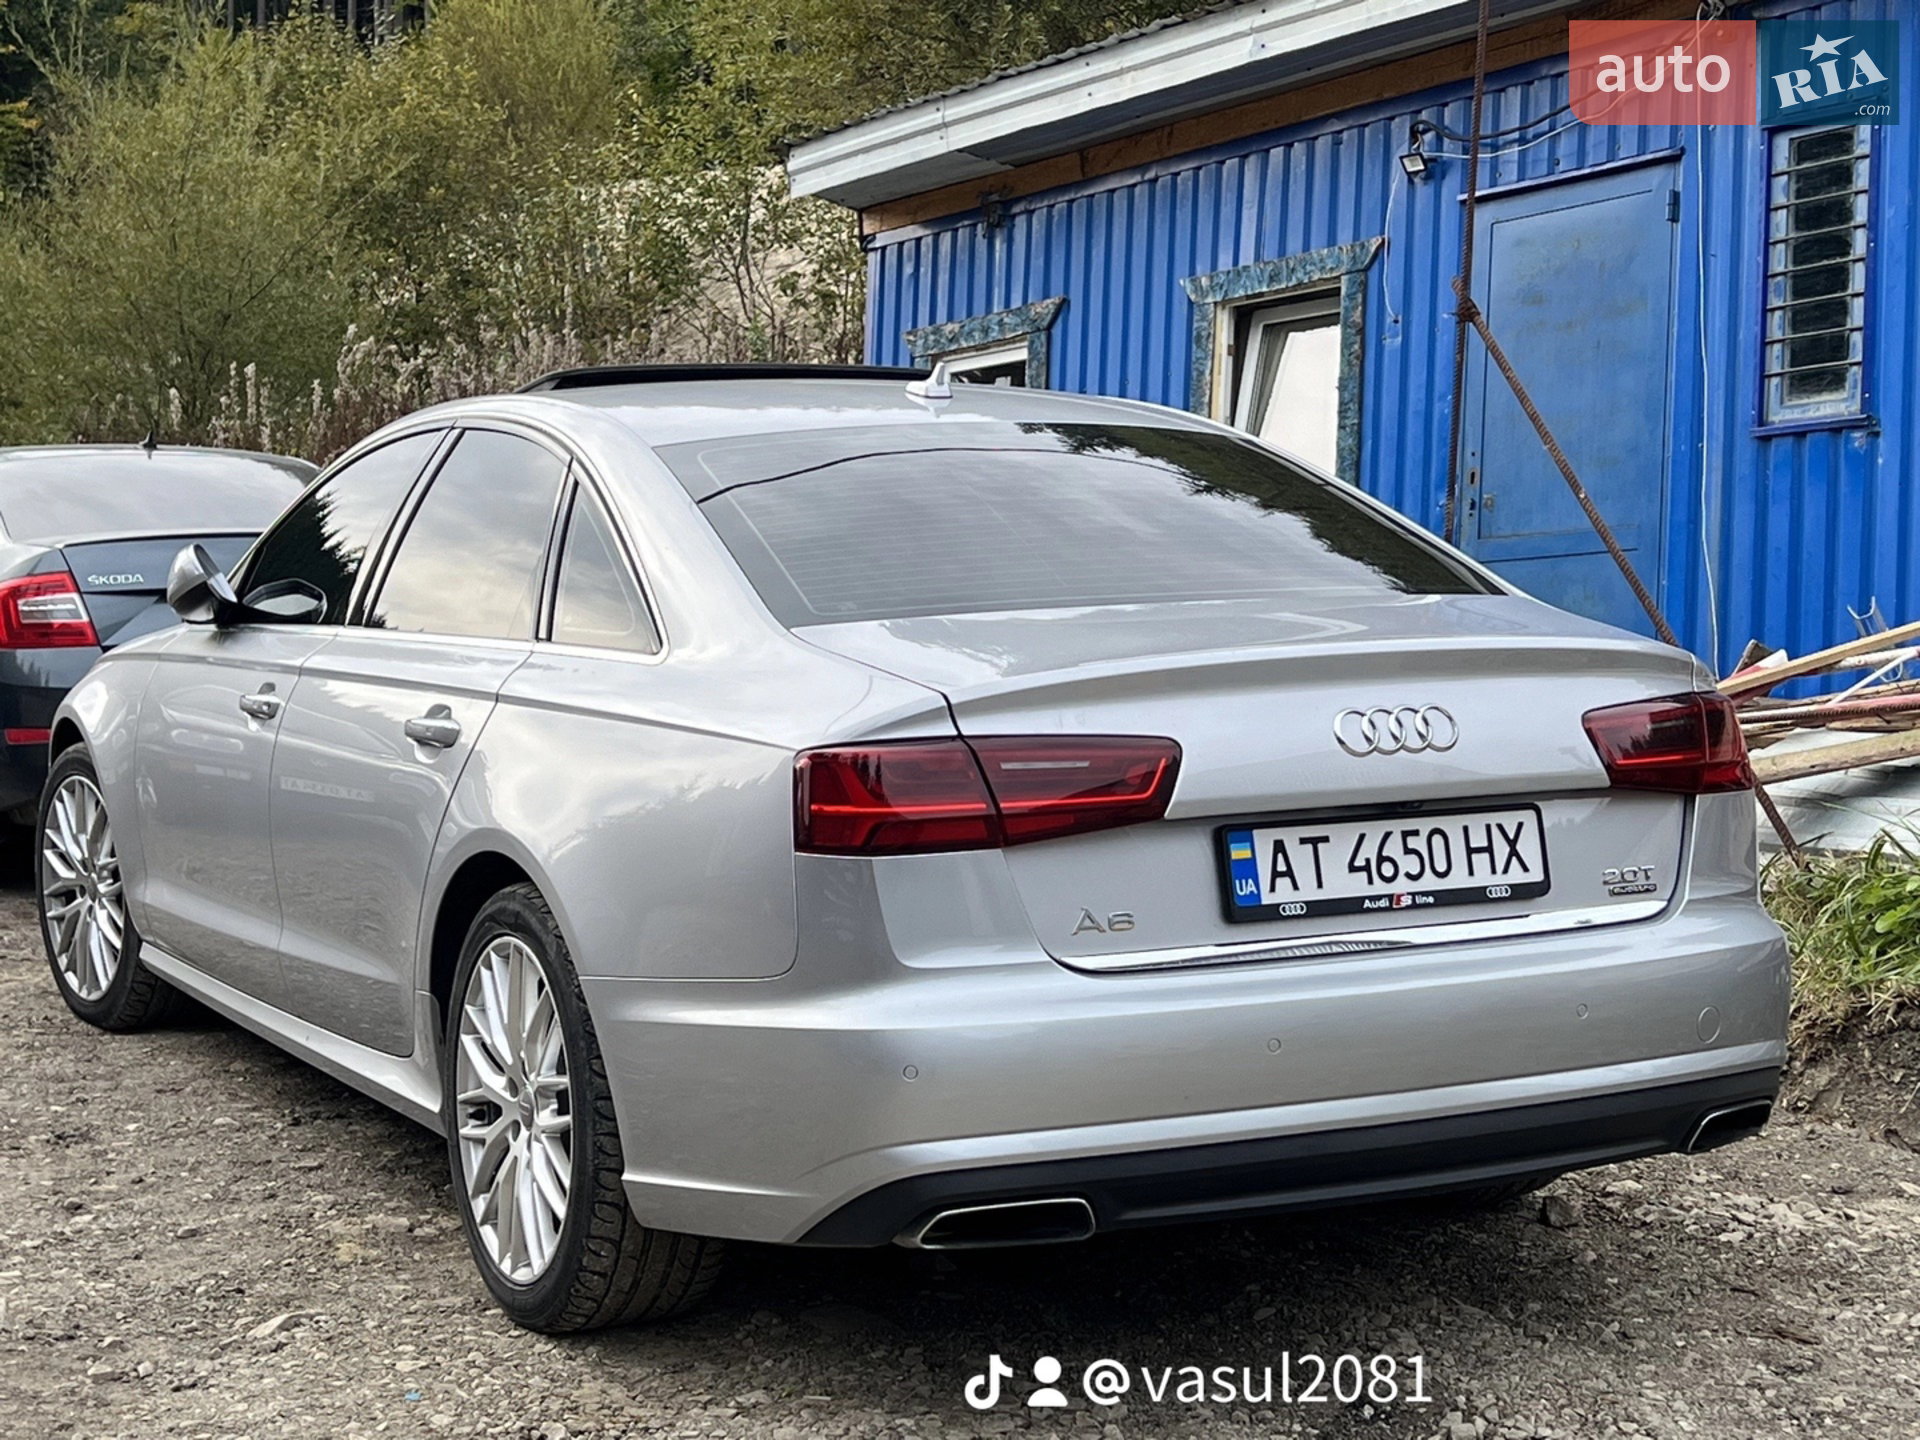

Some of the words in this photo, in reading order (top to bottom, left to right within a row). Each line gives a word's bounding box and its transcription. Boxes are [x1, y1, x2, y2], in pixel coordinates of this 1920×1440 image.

[1268, 836, 1330, 893] AT
[1347, 827, 1451, 886] 4650
[1462, 820, 1531, 877] HX
[1235, 878, 1258, 896] UA
[1363, 897, 1389, 909] Audi
[1415, 894, 1435, 905] line
[1070, 906, 1135, 936] A6
